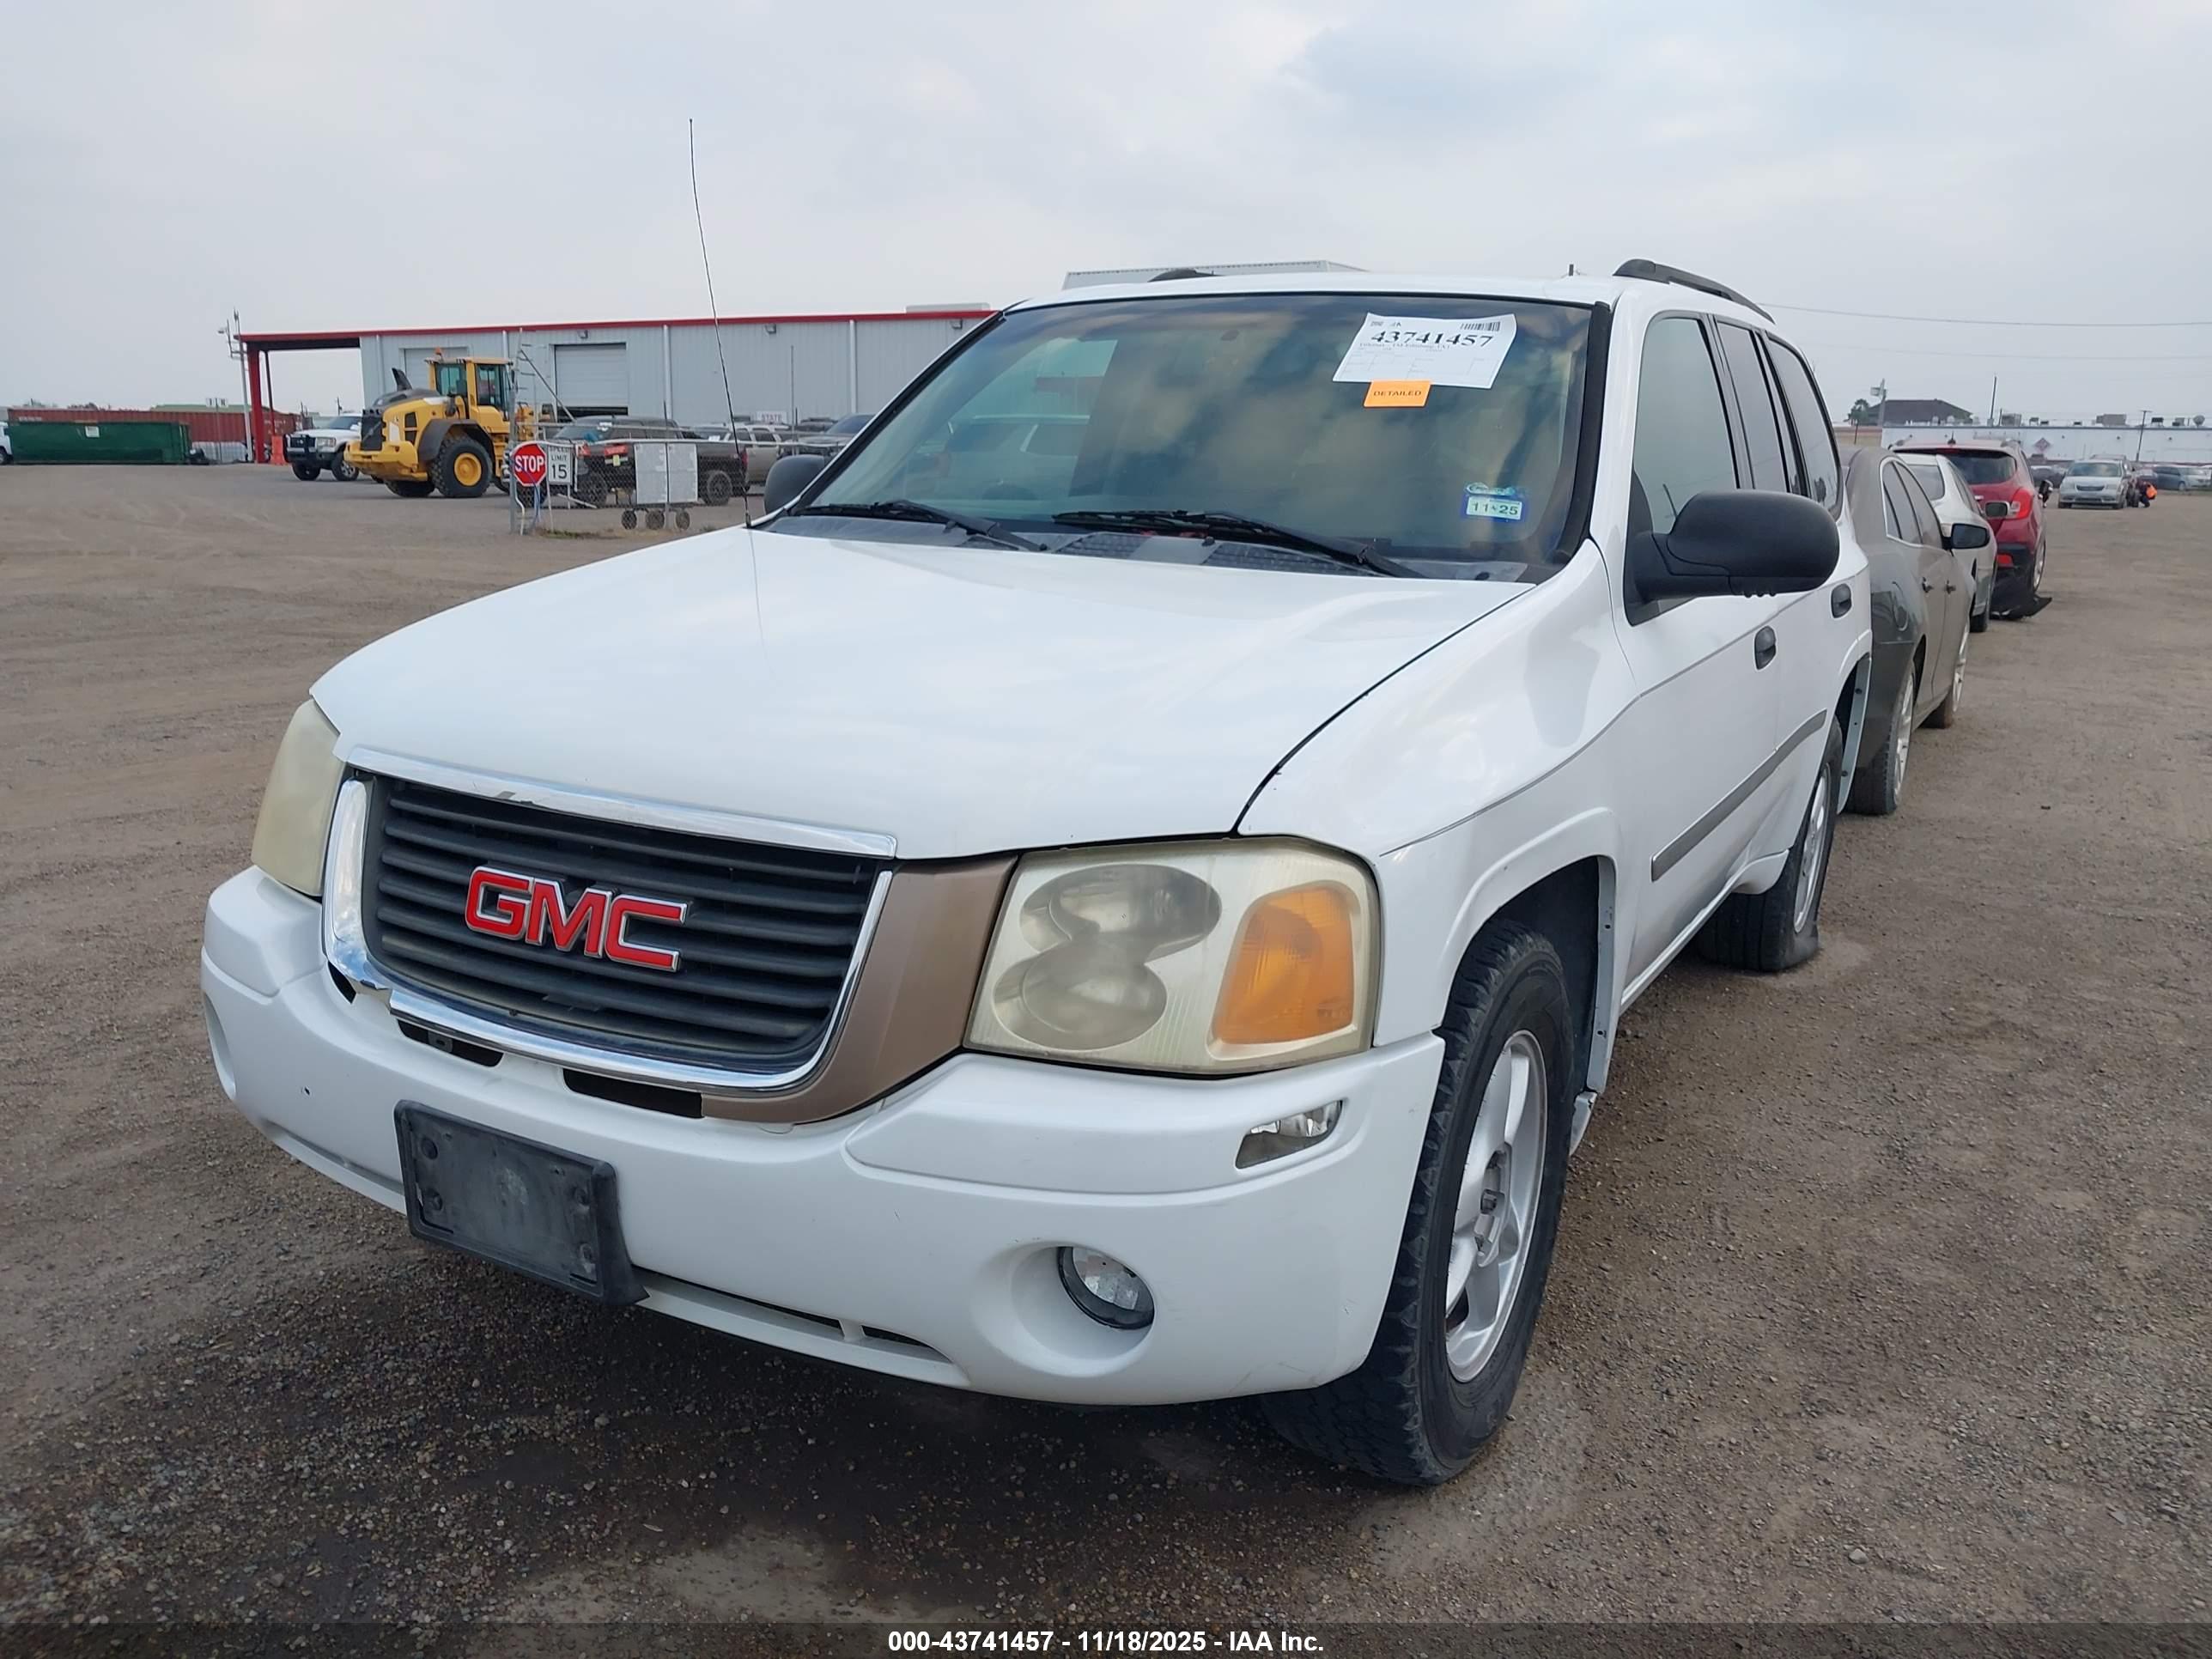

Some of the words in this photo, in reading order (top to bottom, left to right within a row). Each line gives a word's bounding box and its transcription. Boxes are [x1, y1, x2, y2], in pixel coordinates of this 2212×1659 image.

[1370, 331, 1493, 347] 43741457
[514, 454, 545, 473] STOP
[551, 464, 568, 479] 15
[465, 866, 687, 973] GMC
